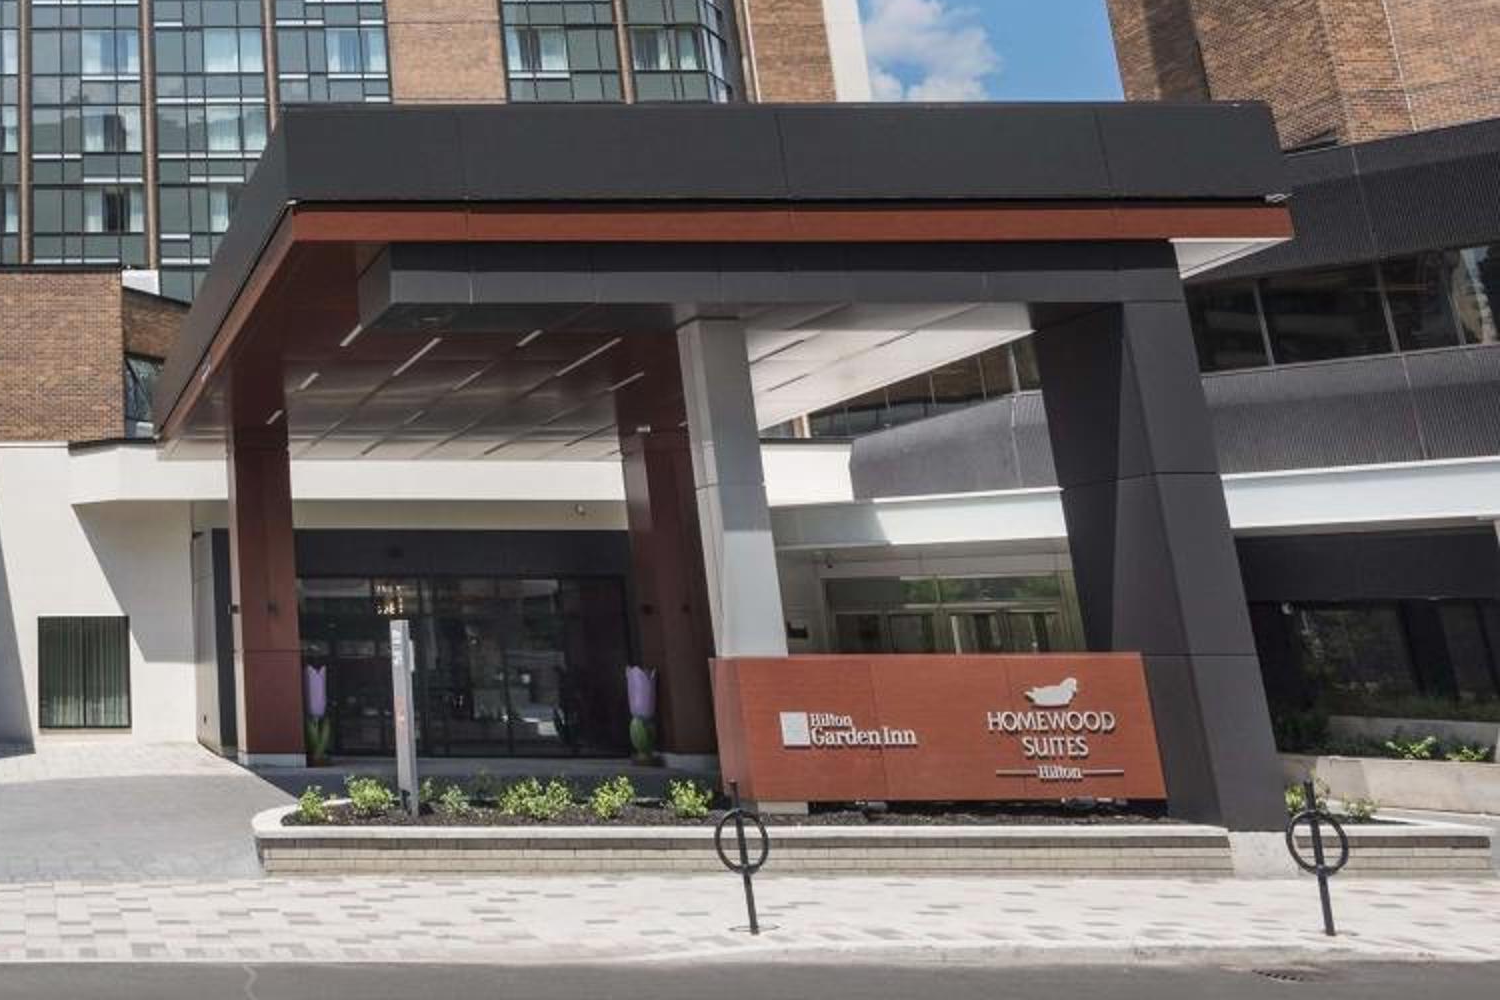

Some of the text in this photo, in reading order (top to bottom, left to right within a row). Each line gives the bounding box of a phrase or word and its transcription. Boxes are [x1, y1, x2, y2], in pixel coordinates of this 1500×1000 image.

[809, 713, 853, 727] Hilton
[987, 711, 1116, 731] HOMEWOOD
[811, 726, 917, 745] Garden Inn
[1021, 736, 1089, 756] SUITES
[1036, 765, 1083, 779] Hilton
